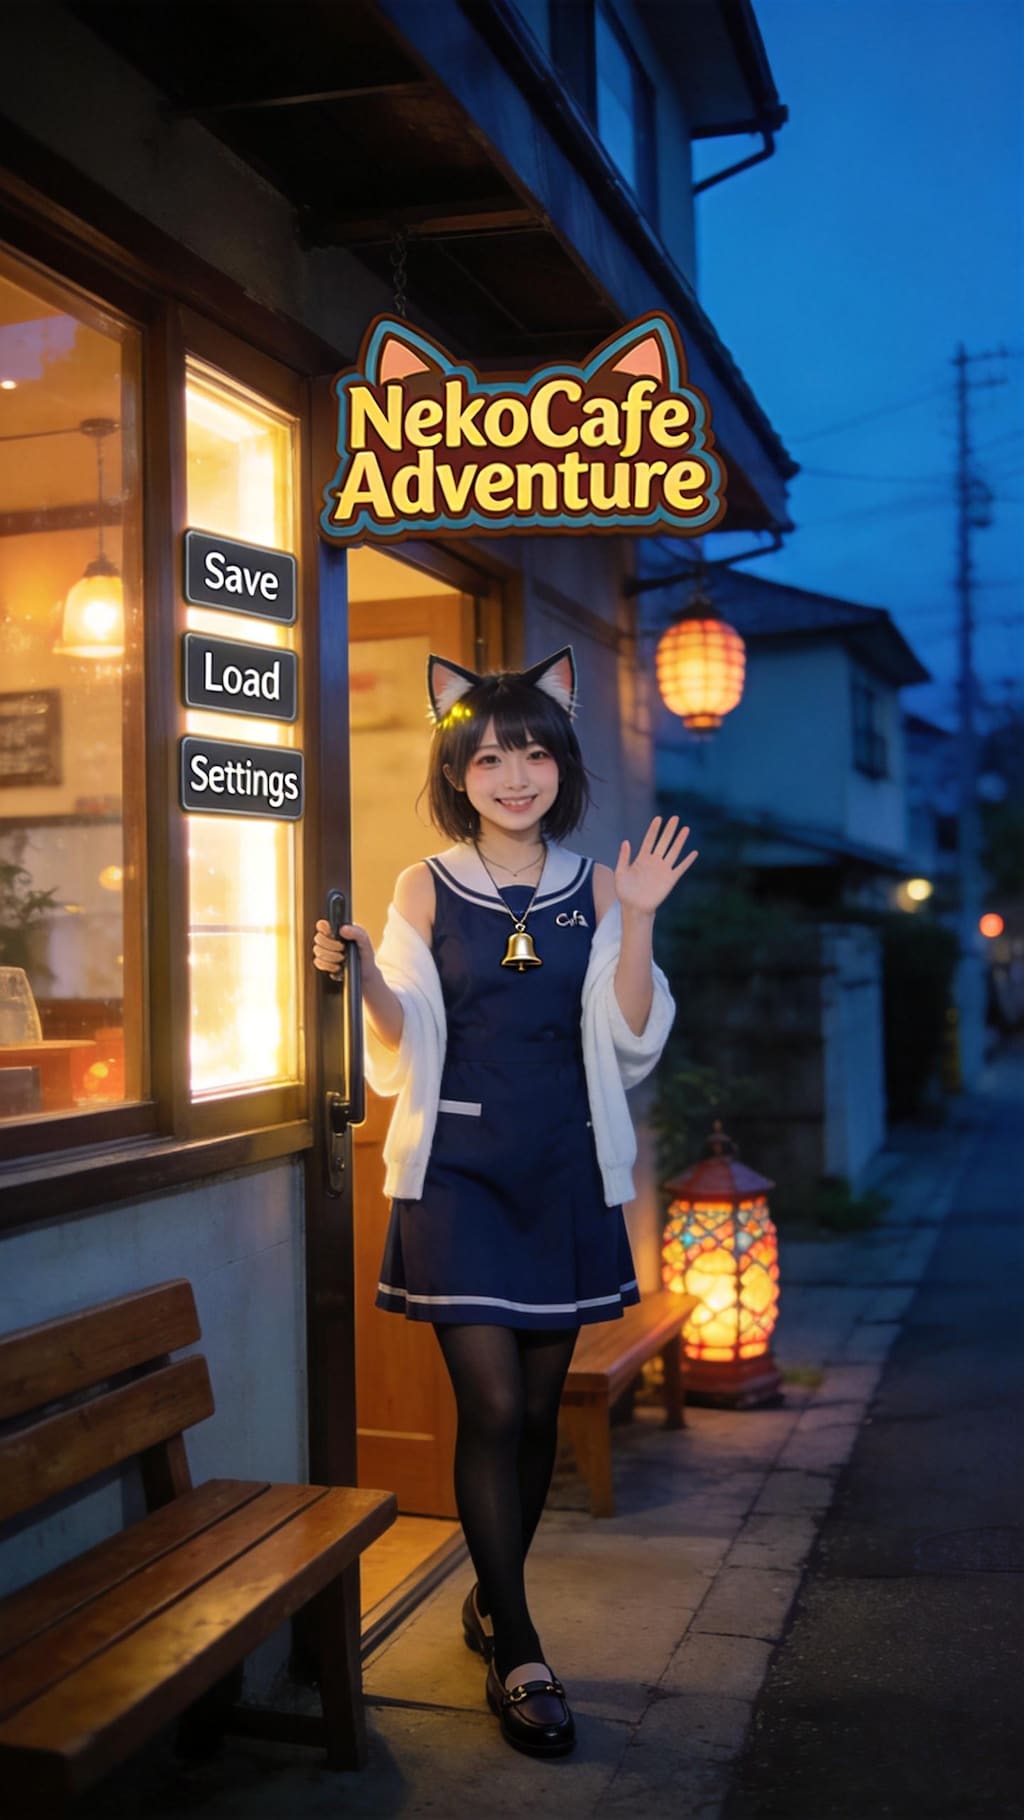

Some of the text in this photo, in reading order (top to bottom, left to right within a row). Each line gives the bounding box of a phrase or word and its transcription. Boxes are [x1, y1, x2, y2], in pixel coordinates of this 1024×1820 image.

[349, 379, 690, 458] NekoCafe
[334, 449, 706, 519] Adventure
[204, 551, 279, 601] Save
[204, 652, 280, 701] Load
[190, 754, 299, 808] Settings
